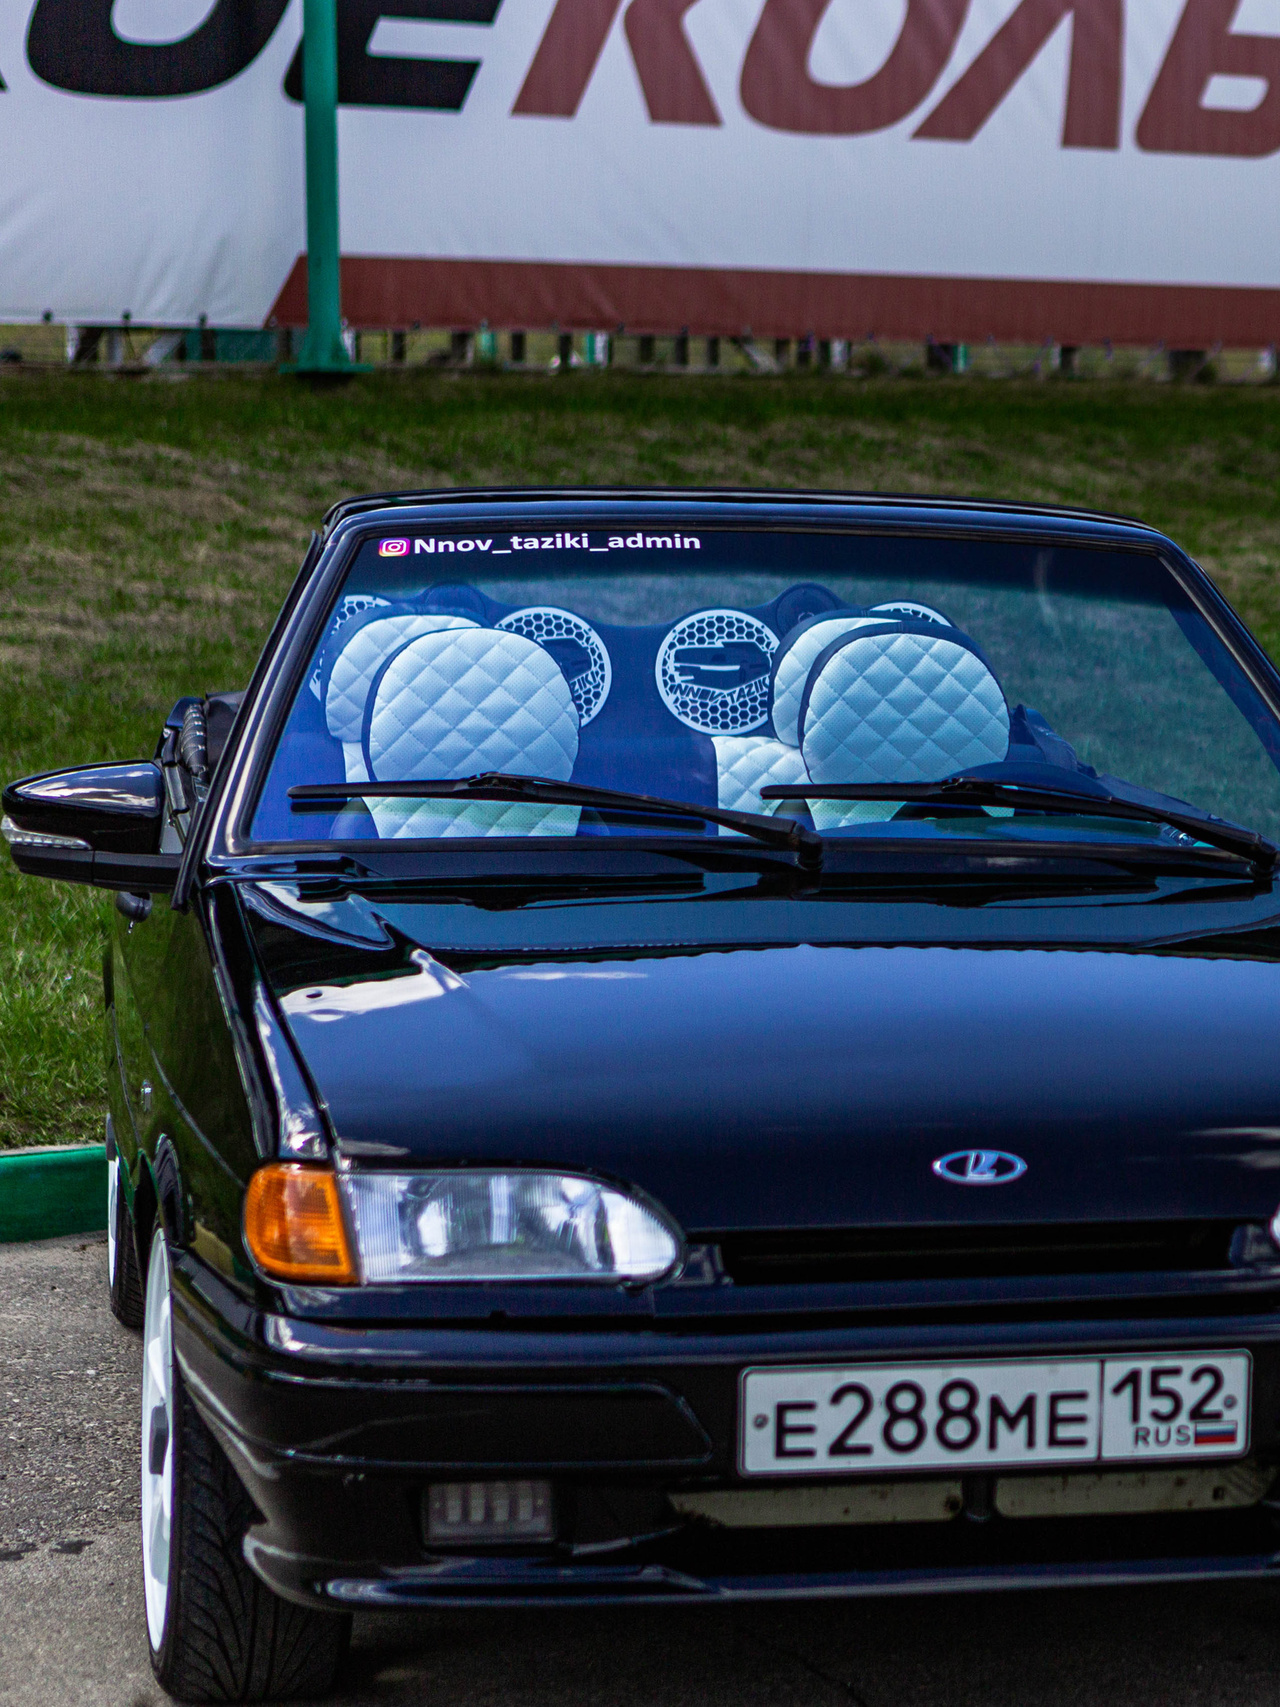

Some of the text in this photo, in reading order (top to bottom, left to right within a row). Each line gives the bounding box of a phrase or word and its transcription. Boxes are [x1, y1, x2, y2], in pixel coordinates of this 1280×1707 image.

[414, 533, 701, 554] Nnov_taziki_admin
[1111, 1364, 1224, 1424] 152
[1133, 1424, 1190, 1447] RUS
